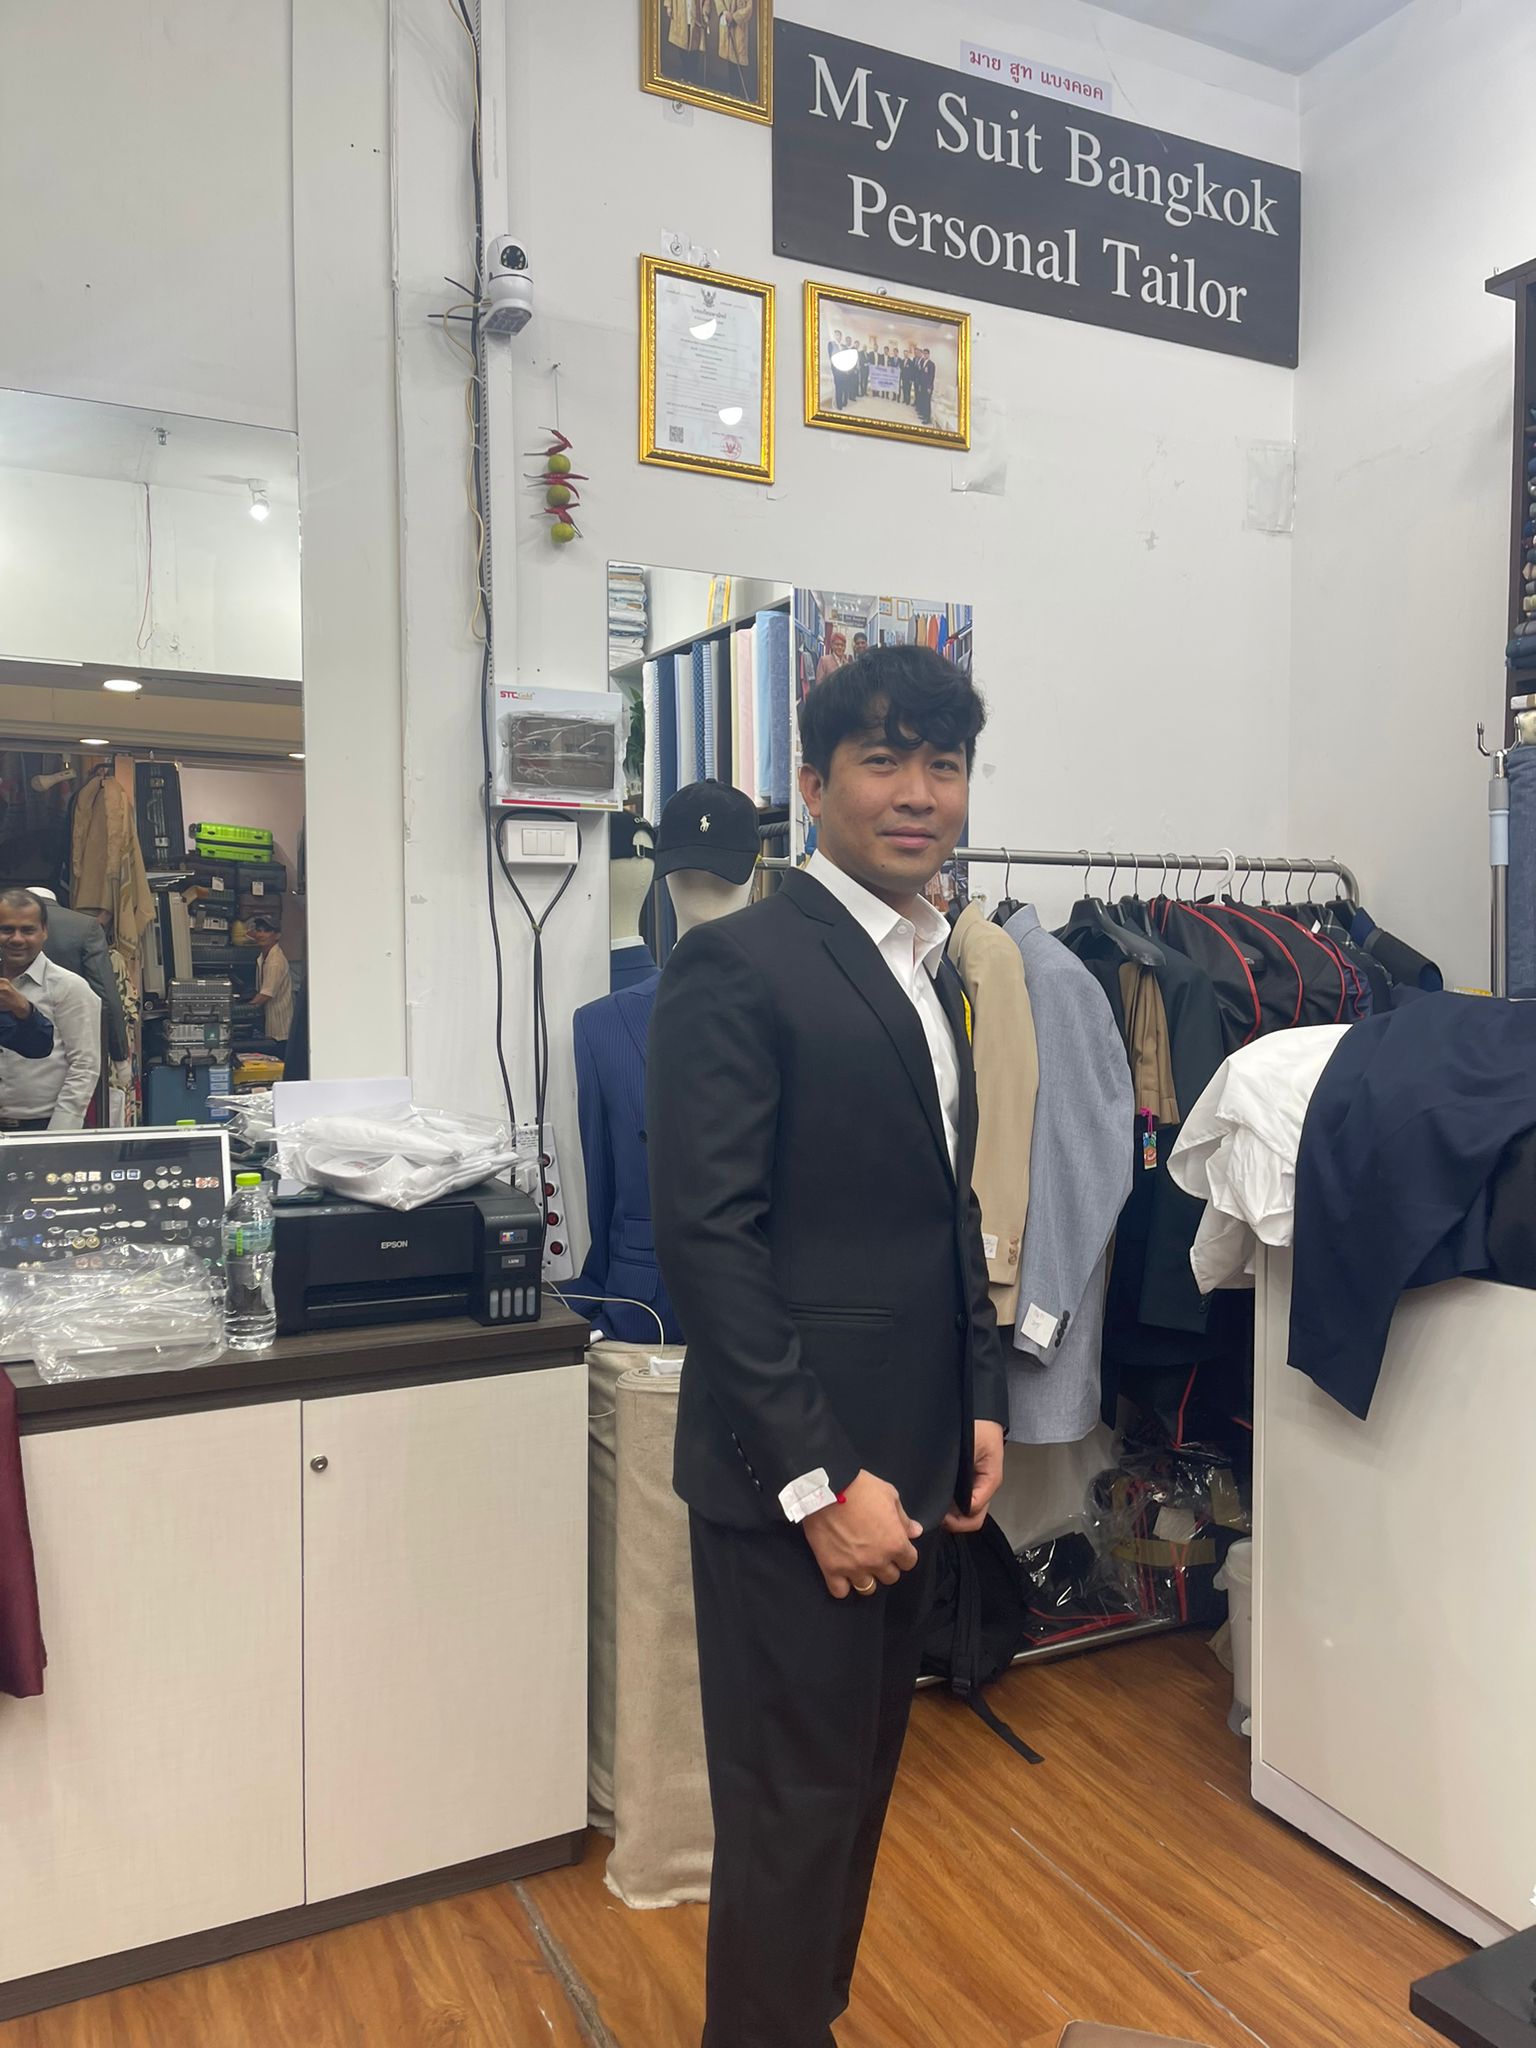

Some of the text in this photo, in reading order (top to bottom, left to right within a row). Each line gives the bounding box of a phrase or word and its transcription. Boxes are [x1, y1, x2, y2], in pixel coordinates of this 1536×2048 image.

[969, 51, 1001, 71] มาย
[1009, 62, 1033, 84] สูท
[808, 53, 1280, 236] My Suit Bangkok
[847, 173, 1248, 324] Personal Tailor
[500, 690, 518, 699] STC
[380, 1240, 409, 1249] EPSON
